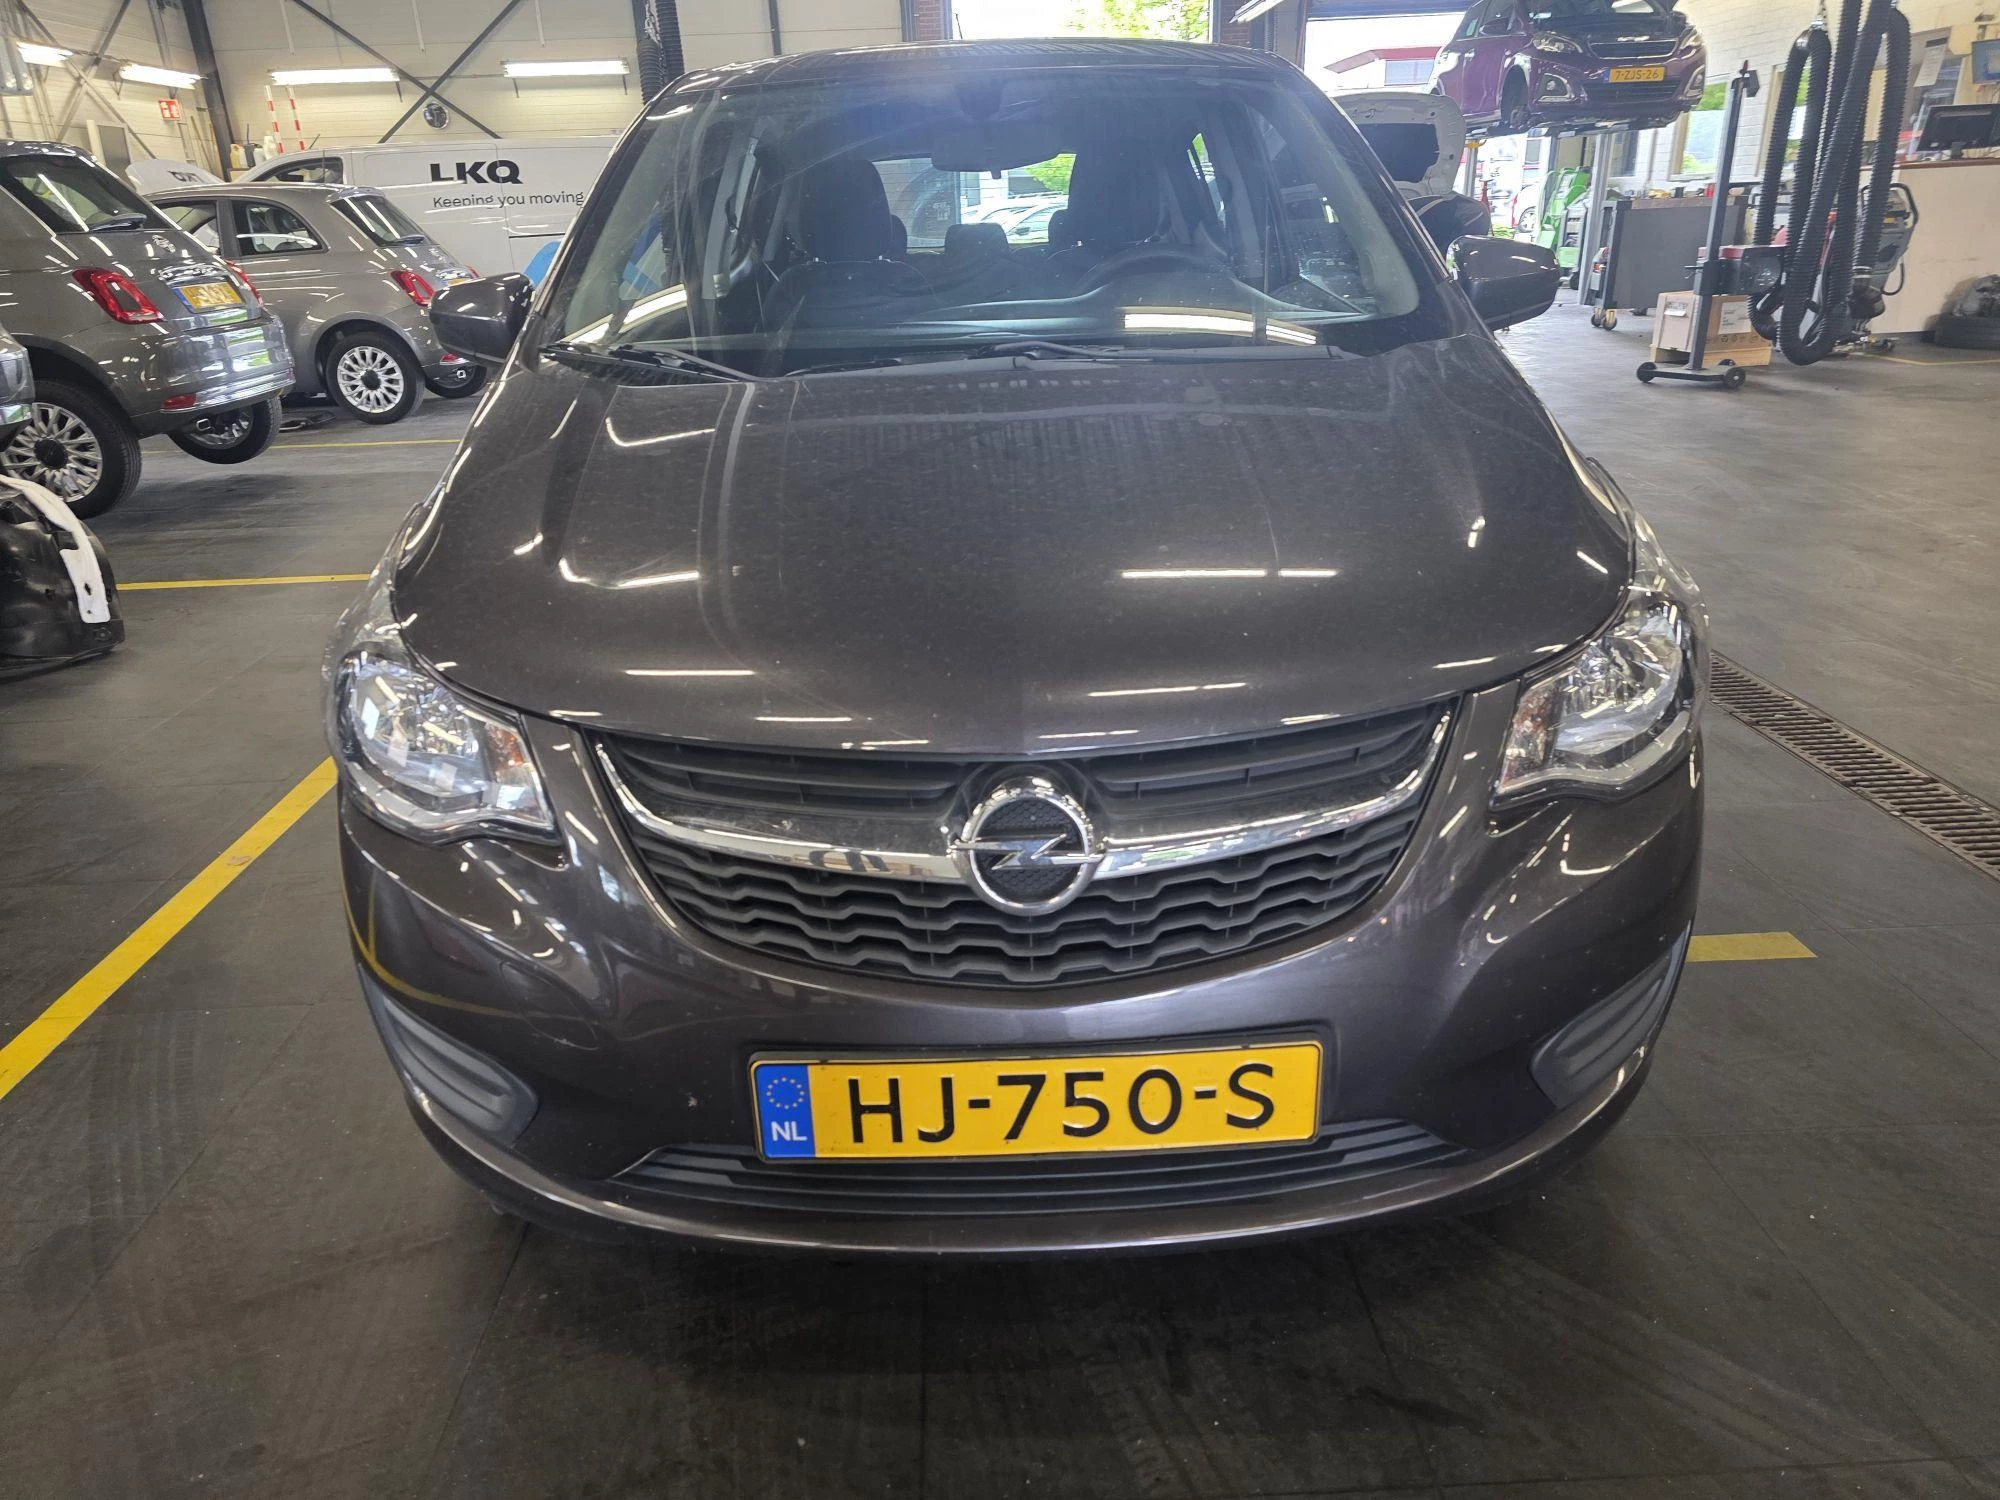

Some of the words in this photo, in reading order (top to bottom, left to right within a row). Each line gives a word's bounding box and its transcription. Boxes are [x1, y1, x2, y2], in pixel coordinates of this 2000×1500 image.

[1615, 68, 1660, 81] 7-ZJS-26
[430, 159, 524, 185] LKQ
[433, 194, 494, 209] Keeping
[498, 195, 525, 209] you
[530, 190, 584, 207] moving
[848, 1062, 1275, 1144] HJ-750-S
[771, 1121, 808, 1142] NL
